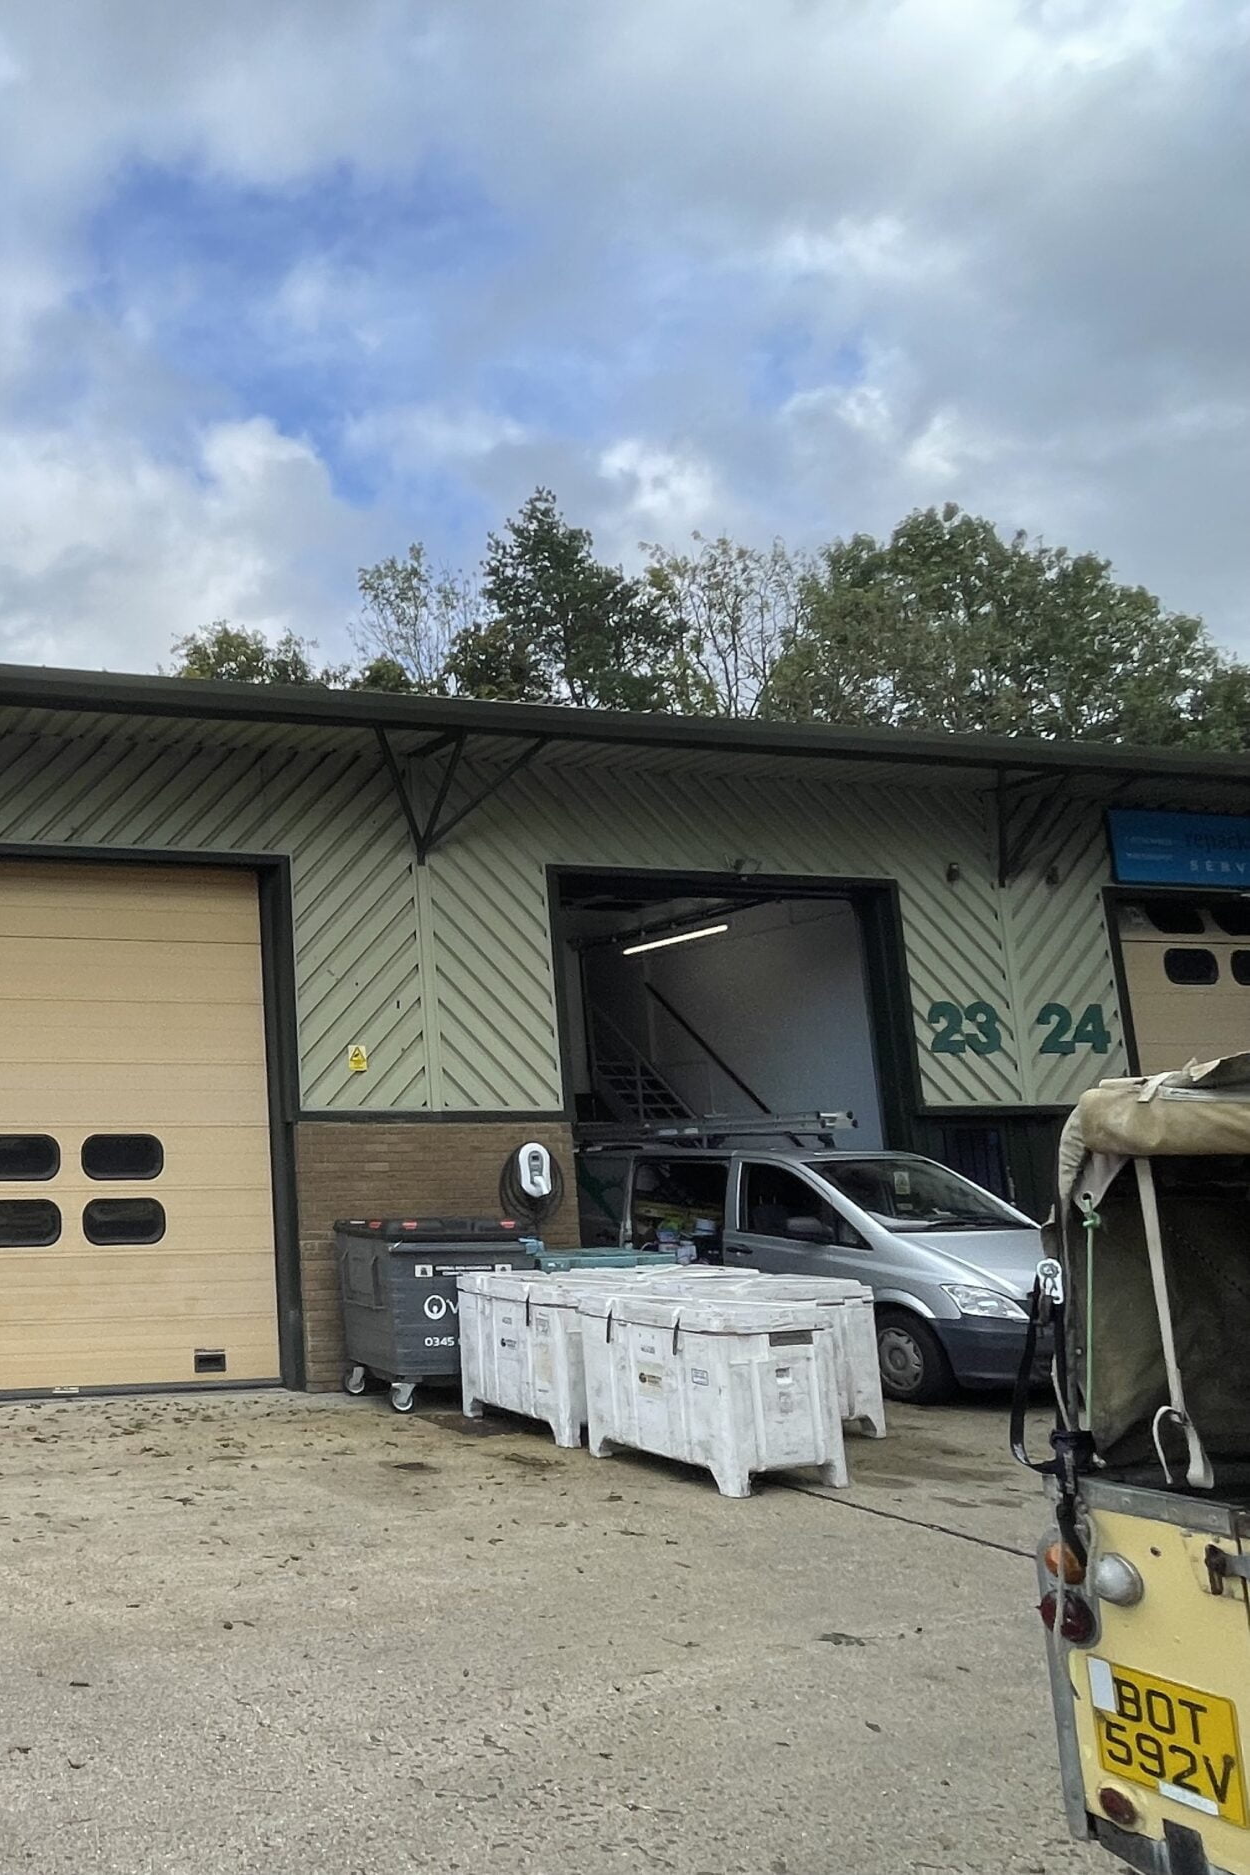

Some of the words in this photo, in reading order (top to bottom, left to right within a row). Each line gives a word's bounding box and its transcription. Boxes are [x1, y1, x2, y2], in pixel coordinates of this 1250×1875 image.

[927, 1001, 1002, 1055] 23
[1037, 1002, 1112, 1054] 24
[424, 1336, 455, 1347] 0345
[1114, 1677, 1208, 1745] BOT
[1105, 1720, 1235, 1804] 592V
